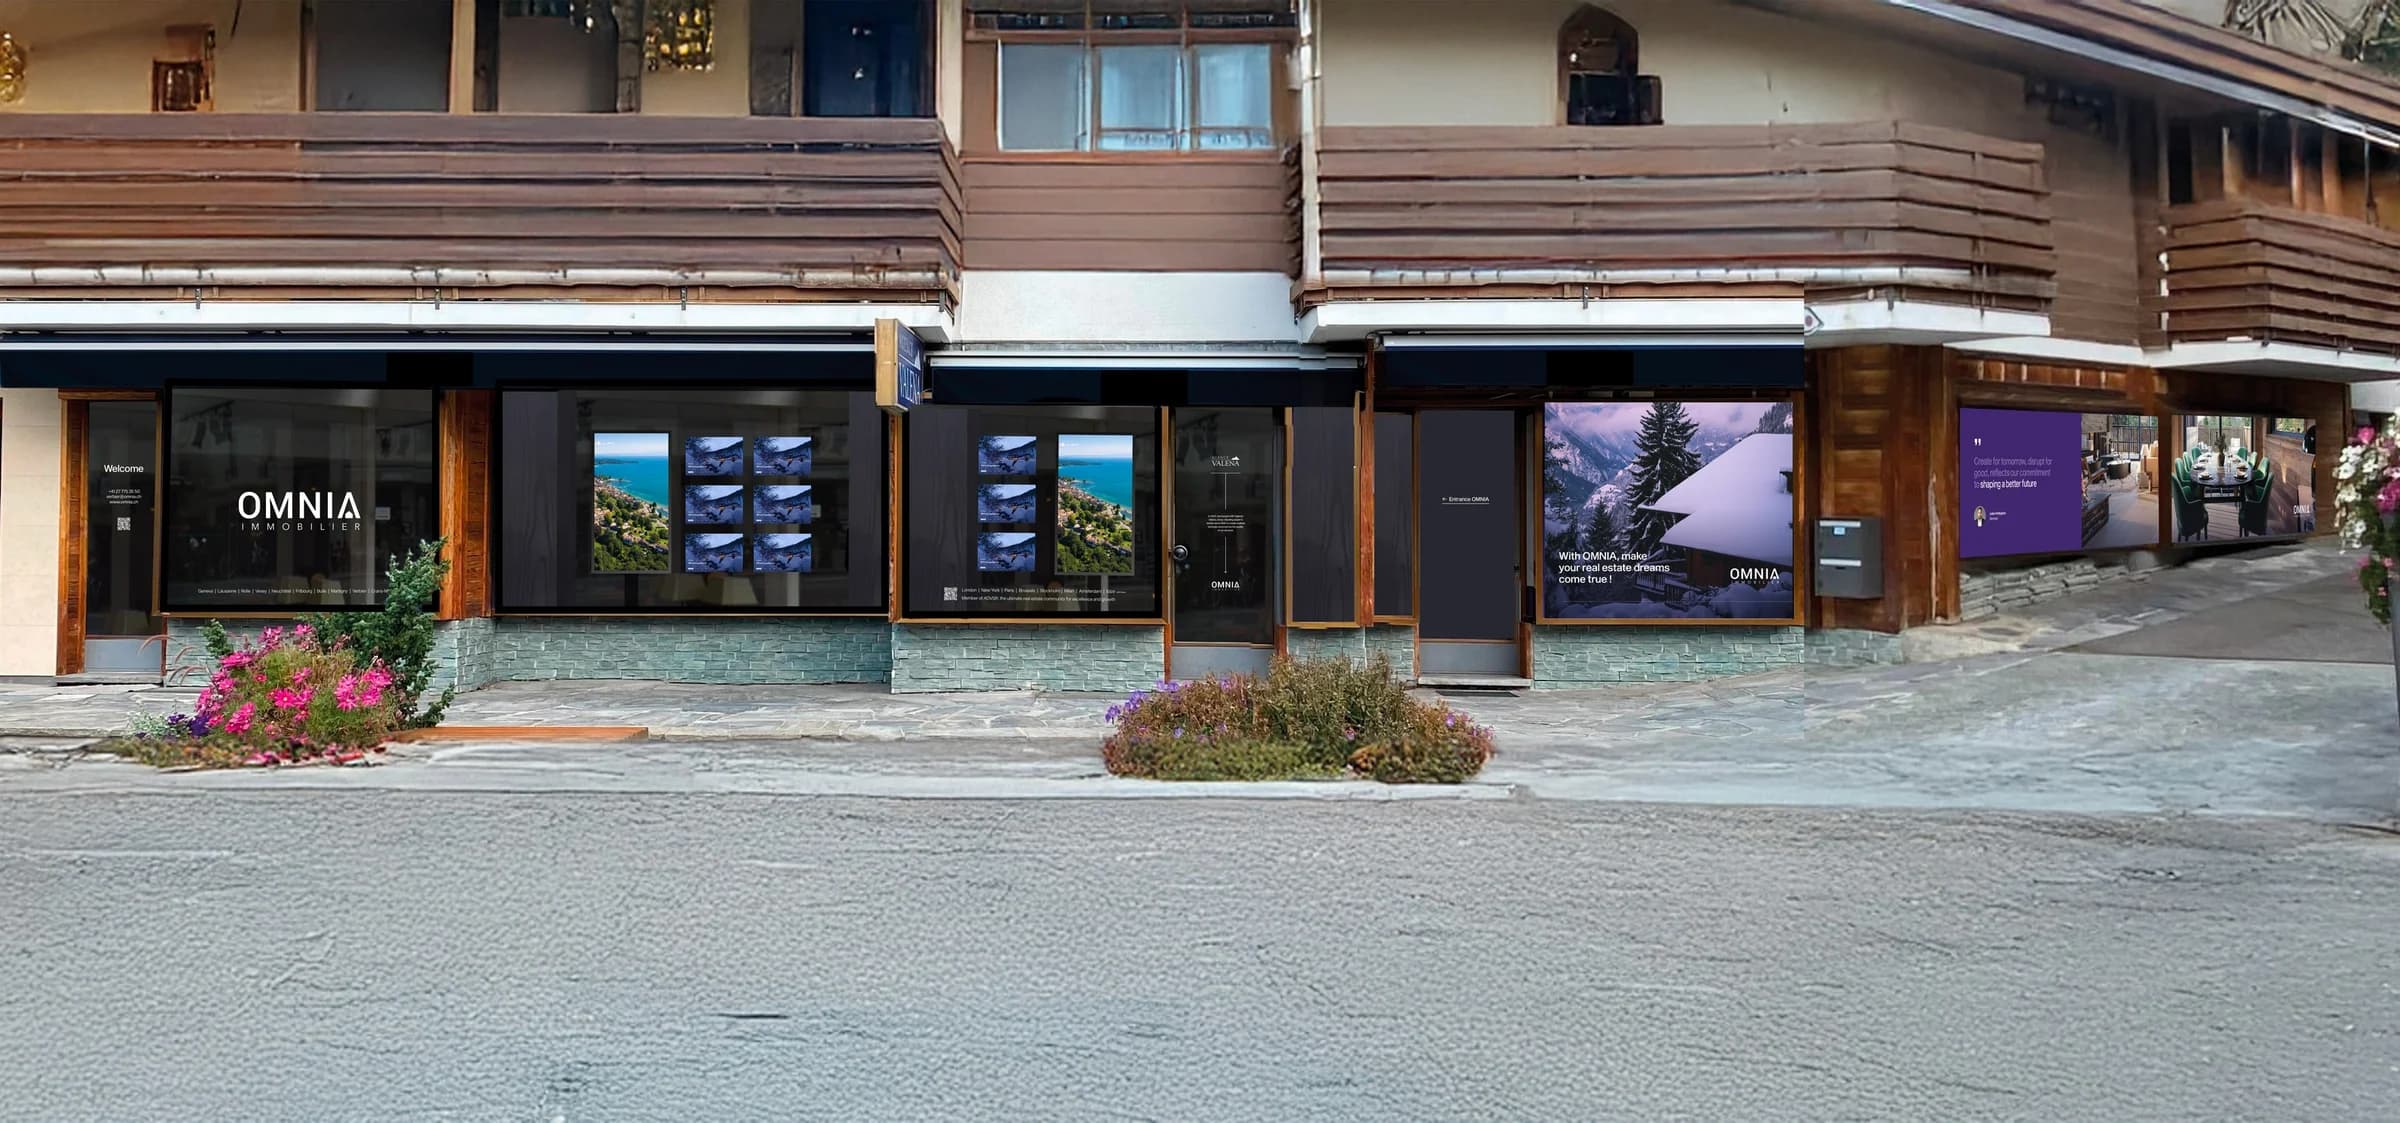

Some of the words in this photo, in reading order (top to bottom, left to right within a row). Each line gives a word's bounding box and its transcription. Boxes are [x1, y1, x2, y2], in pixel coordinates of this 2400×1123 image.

[1974, 457, 1992, 466] Create
[2045, 457, 2053, 466] for
[103, 464, 144, 473] Welcome
[1980, 480, 2001, 490] shaping
[2006, 480, 2021, 488] better
[2021, 479, 2037, 488] future
[238, 491, 361, 519] OMNIA
[2292, 504, 2311, 514] OMNIA
[241, 522, 361, 531] IMMOBILIER
[1559, 551, 1581, 561] With
[1582, 551, 1620, 562] OMNIA,
[1621, 551, 1648, 561] make
[1558, 564, 1580, 574] your
[1582, 563, 1600, 572] real
[1602, 564, 1632, 572] estate
[1633, 563, 1671, 572] dreams
[1729, 567, 1780, 580] OMNIA
[1211, 580, 1240, 589] OMNIA
[1558, 576, 1586, 584] come
[1587, 575, 1608, 584] true
